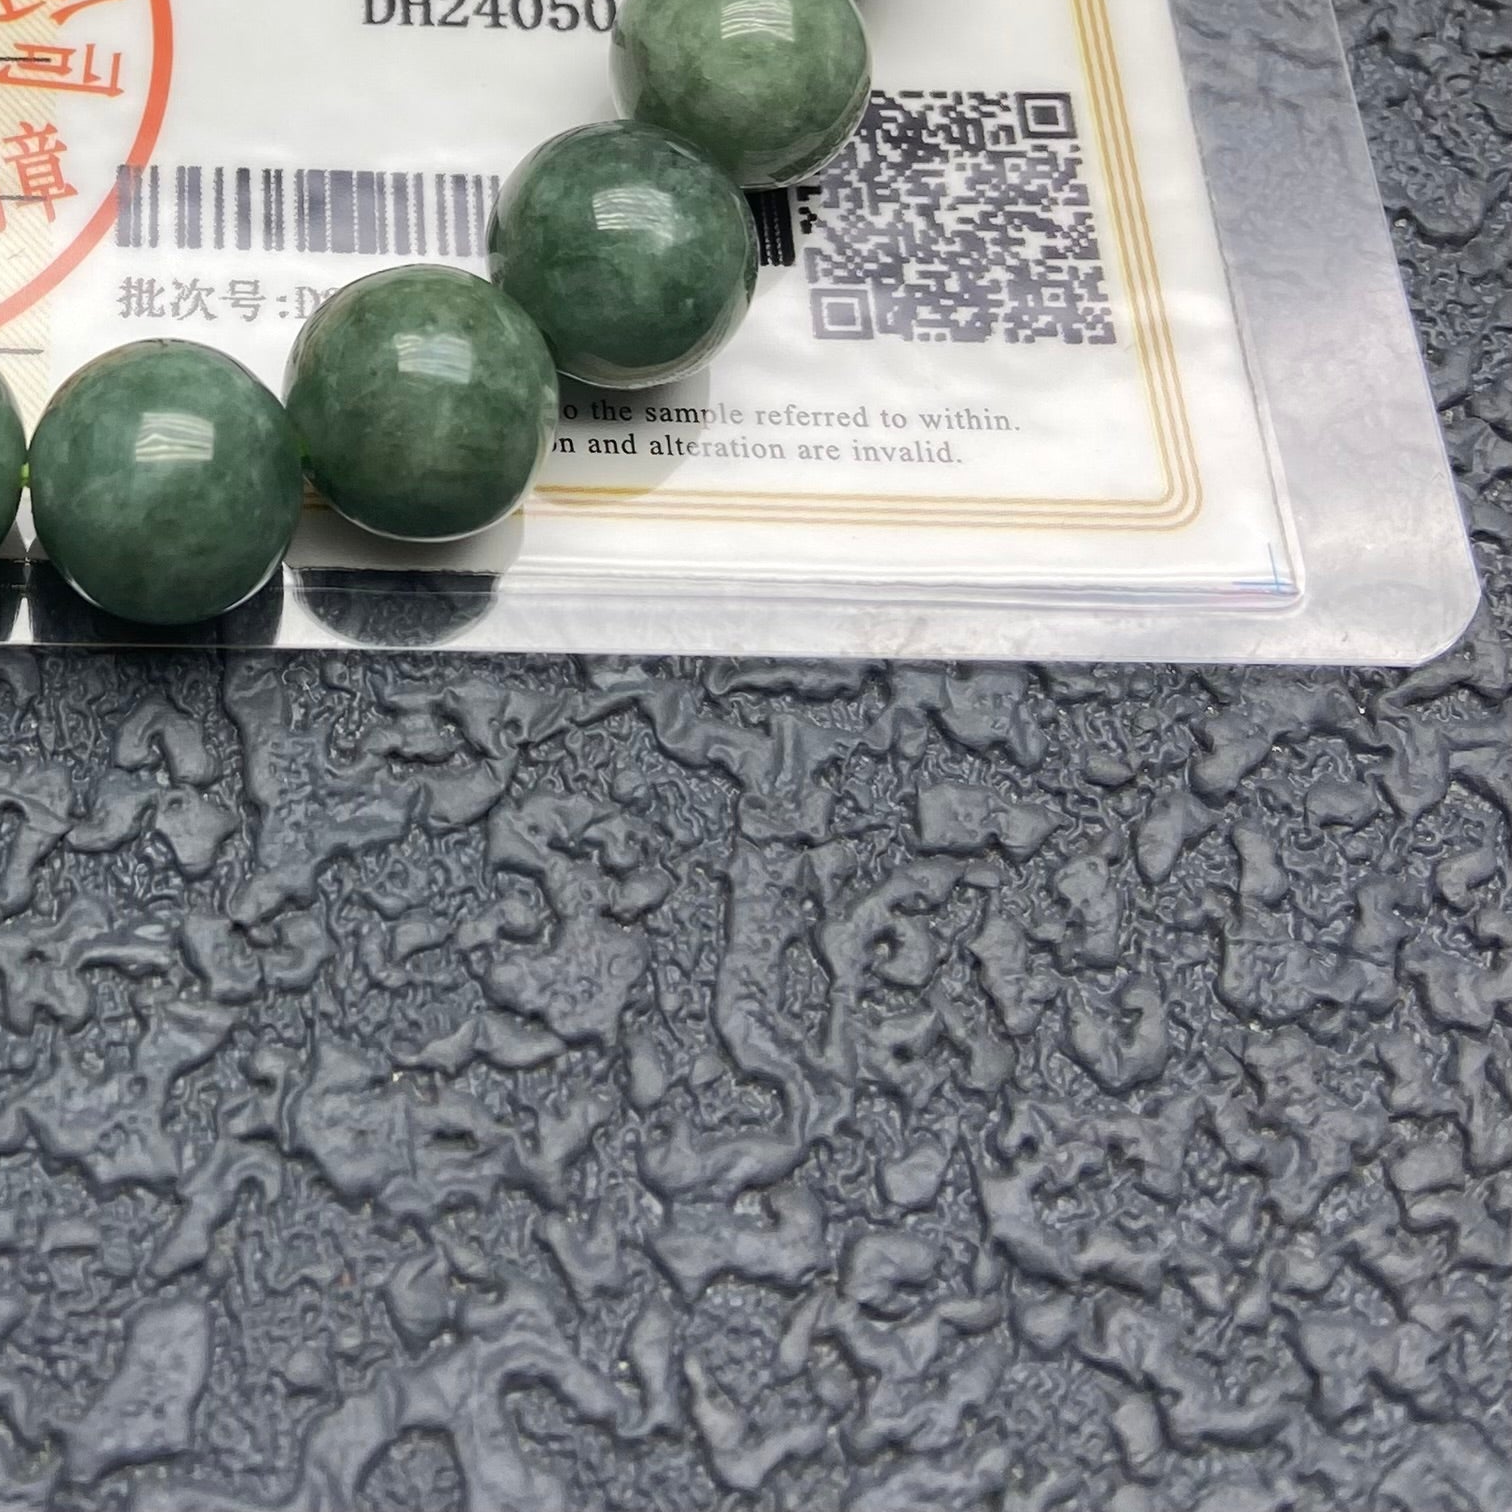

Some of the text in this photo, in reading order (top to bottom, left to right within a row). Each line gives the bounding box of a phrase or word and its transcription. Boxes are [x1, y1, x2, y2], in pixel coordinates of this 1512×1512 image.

[116, 276, 344, 322] 批次号:D
[591, 400, 633, 422] the
[645, 402, 745, 431] sample
[754, 403, 869, 429] referred
[880, 409, 907, 430] to
[918, 408, 1022, 432] within.
[588, 433, 638, 456] and
[650, 434, 786, 462] alteration
[797, 444, 841, 464] are
[851, 441, 963, 465] invalid.
